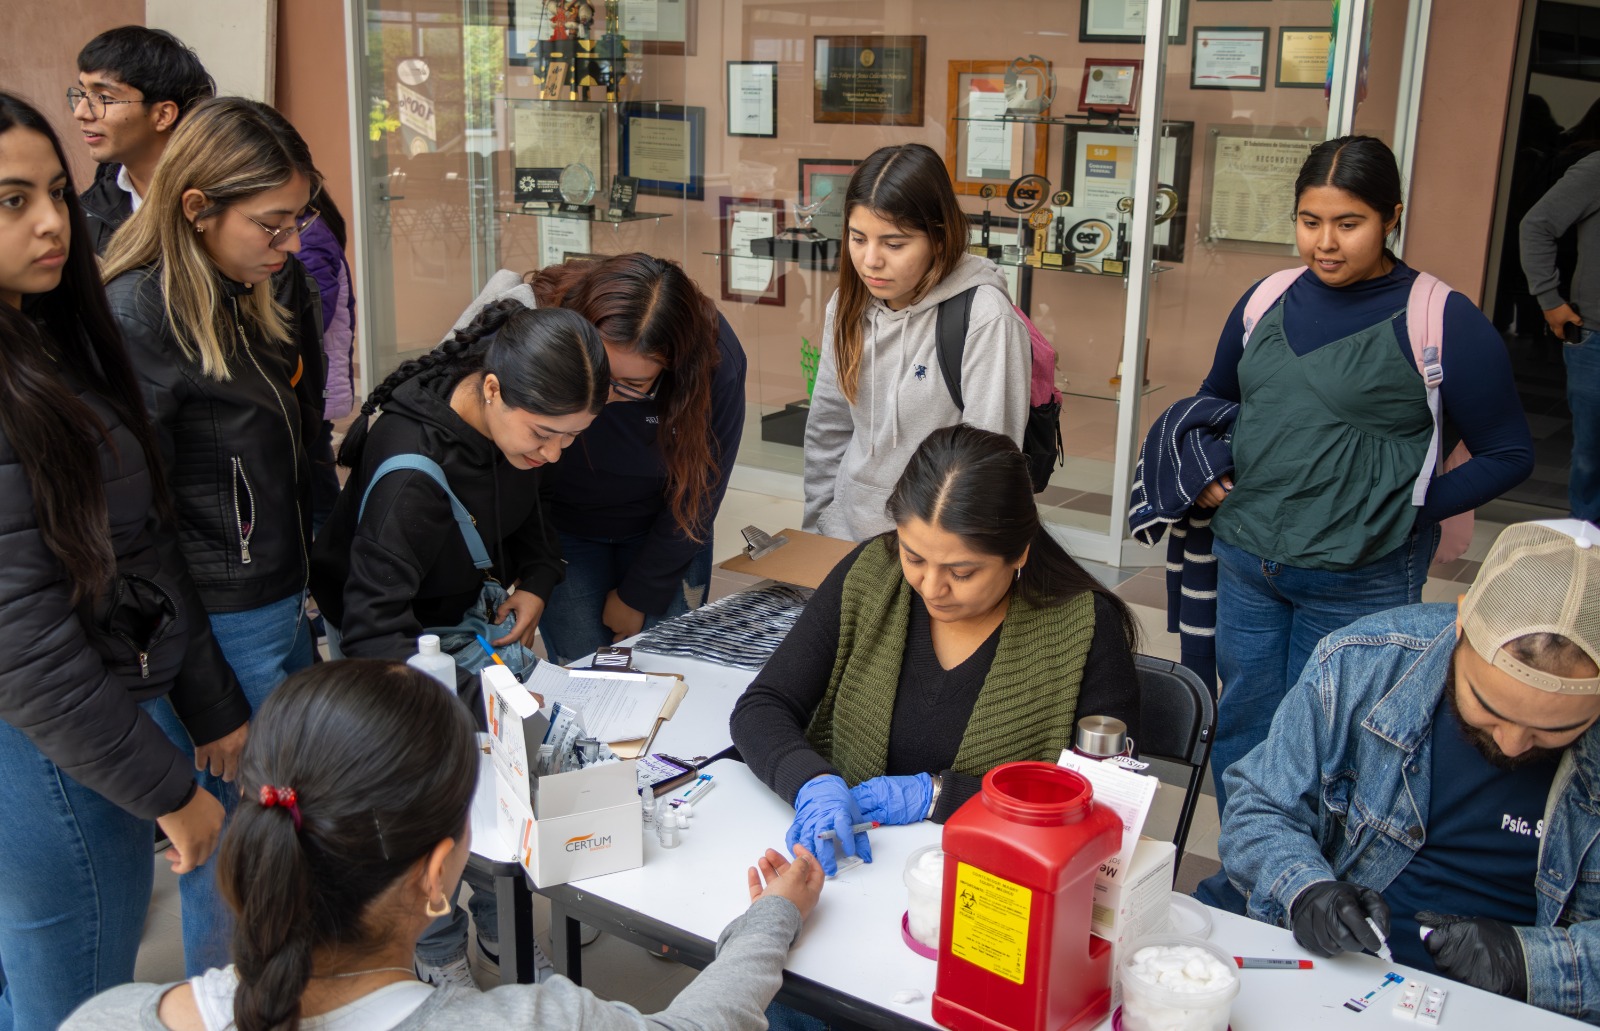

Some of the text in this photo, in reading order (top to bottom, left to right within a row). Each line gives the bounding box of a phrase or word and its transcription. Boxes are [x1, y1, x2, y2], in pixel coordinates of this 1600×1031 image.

[1094, 148, 1109, 156] SEP
[1501, 813, 1531, 836] Psic.
[565, 835, 611, 853] CERTUM
